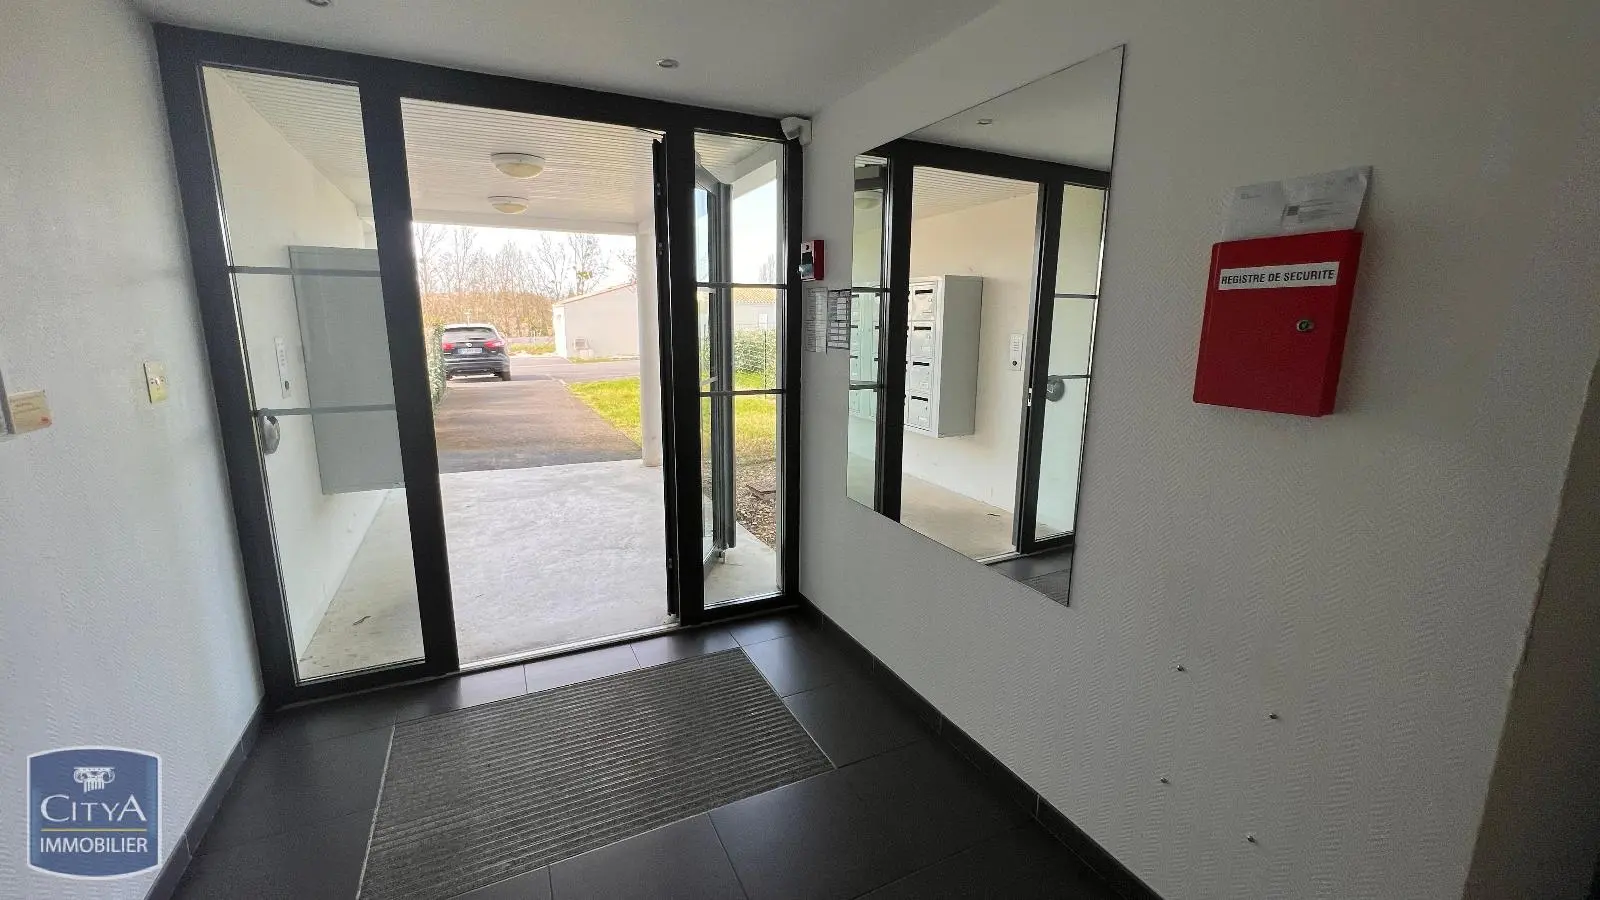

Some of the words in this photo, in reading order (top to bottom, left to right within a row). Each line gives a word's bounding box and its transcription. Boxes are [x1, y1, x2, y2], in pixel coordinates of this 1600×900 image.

[1221, 274, 1265, 285] REGISTRE
[1268, 272, 1281, 282] DE
[1284, 269, 1335, 282] SECURITE
